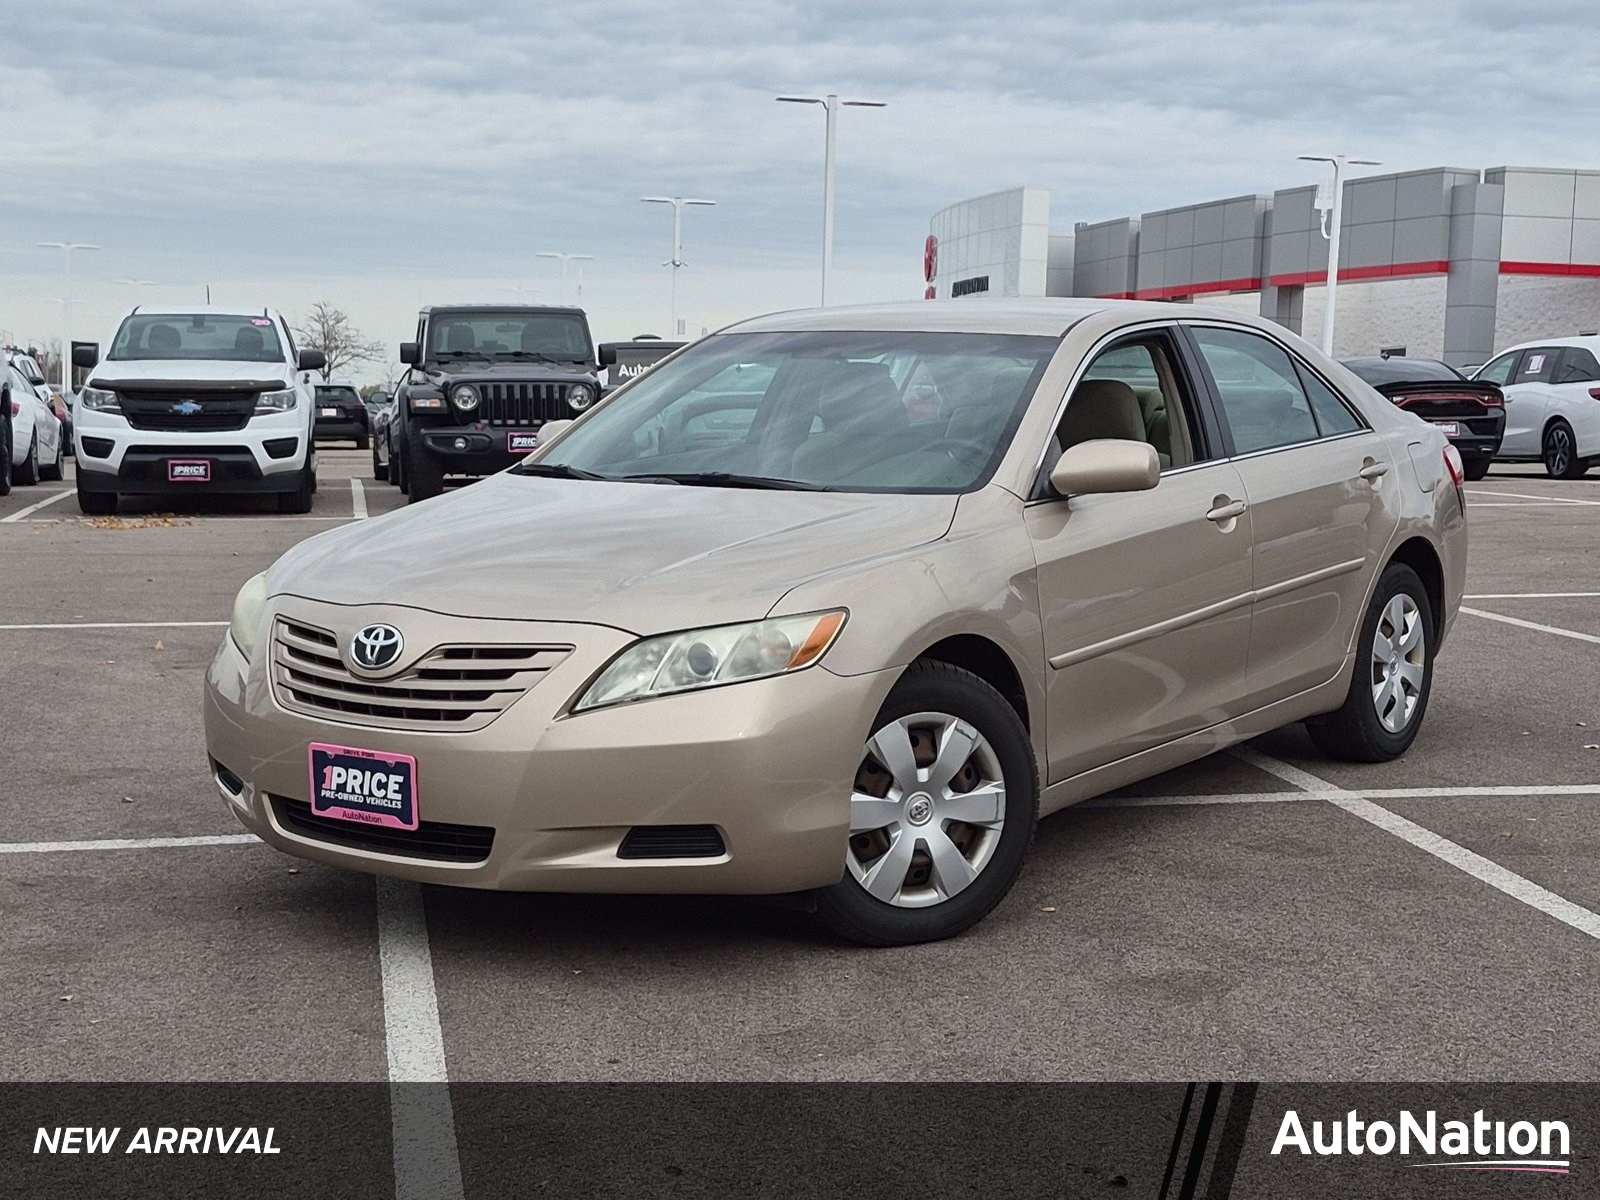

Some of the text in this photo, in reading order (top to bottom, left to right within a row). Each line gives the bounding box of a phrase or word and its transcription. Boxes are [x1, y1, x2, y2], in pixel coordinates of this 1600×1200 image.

[321, 789, 402, 809] PRE-OWNED VEHICLES
[342, 811, 382, 823] AutoNation
